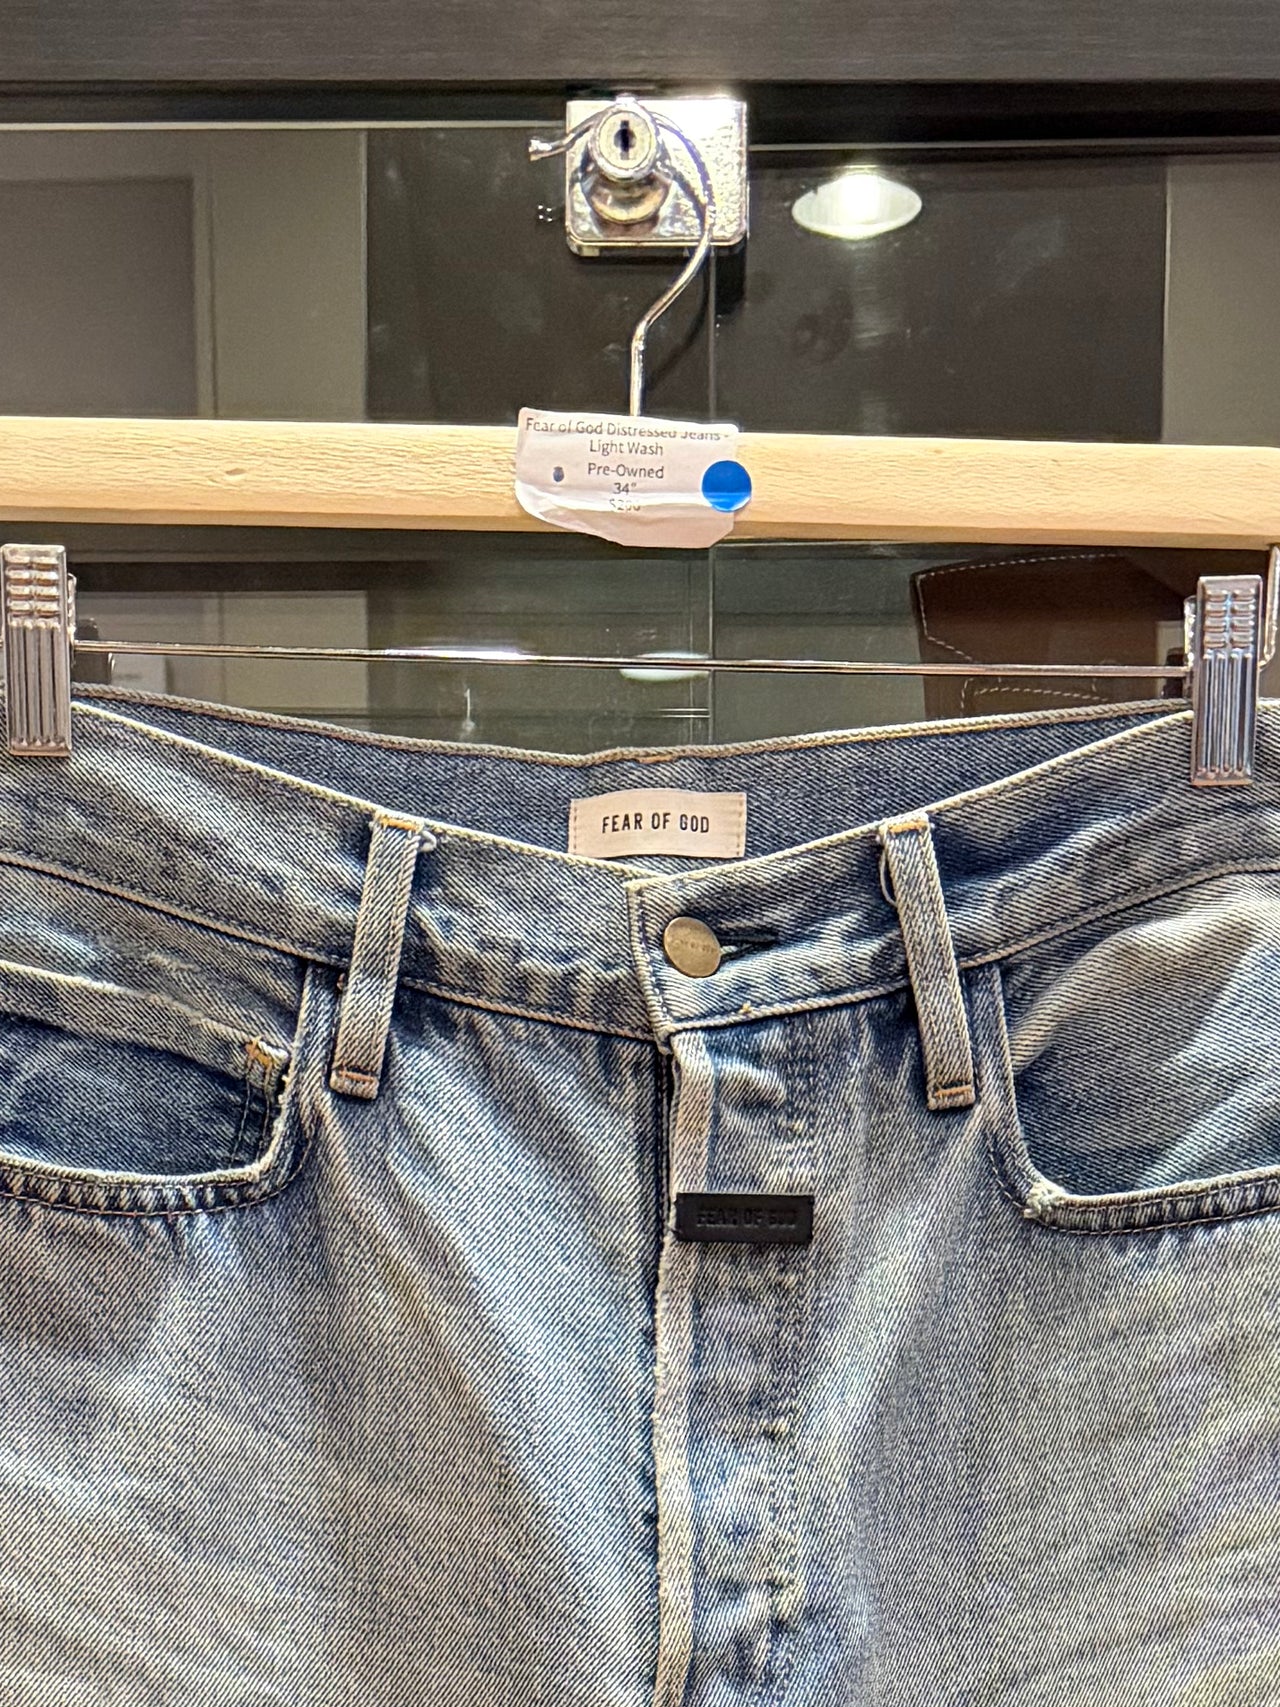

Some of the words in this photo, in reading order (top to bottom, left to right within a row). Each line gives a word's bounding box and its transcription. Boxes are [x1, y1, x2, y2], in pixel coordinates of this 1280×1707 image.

[526, 418, 555, 432] Fear
[559, 420, 572, 433] of
[576, 421, 603, 434] God
[607, 422, 677, 438] Distressed
[590, 440, 624, 456] Light
[627, 442, 664, 456] Wash
[588, 462, 664, 479] Pre-Owned
[601, 812, 643, 834] FEAR
[651, 812, 671, 830] OF
[679, 813, 710, 834] GOD
